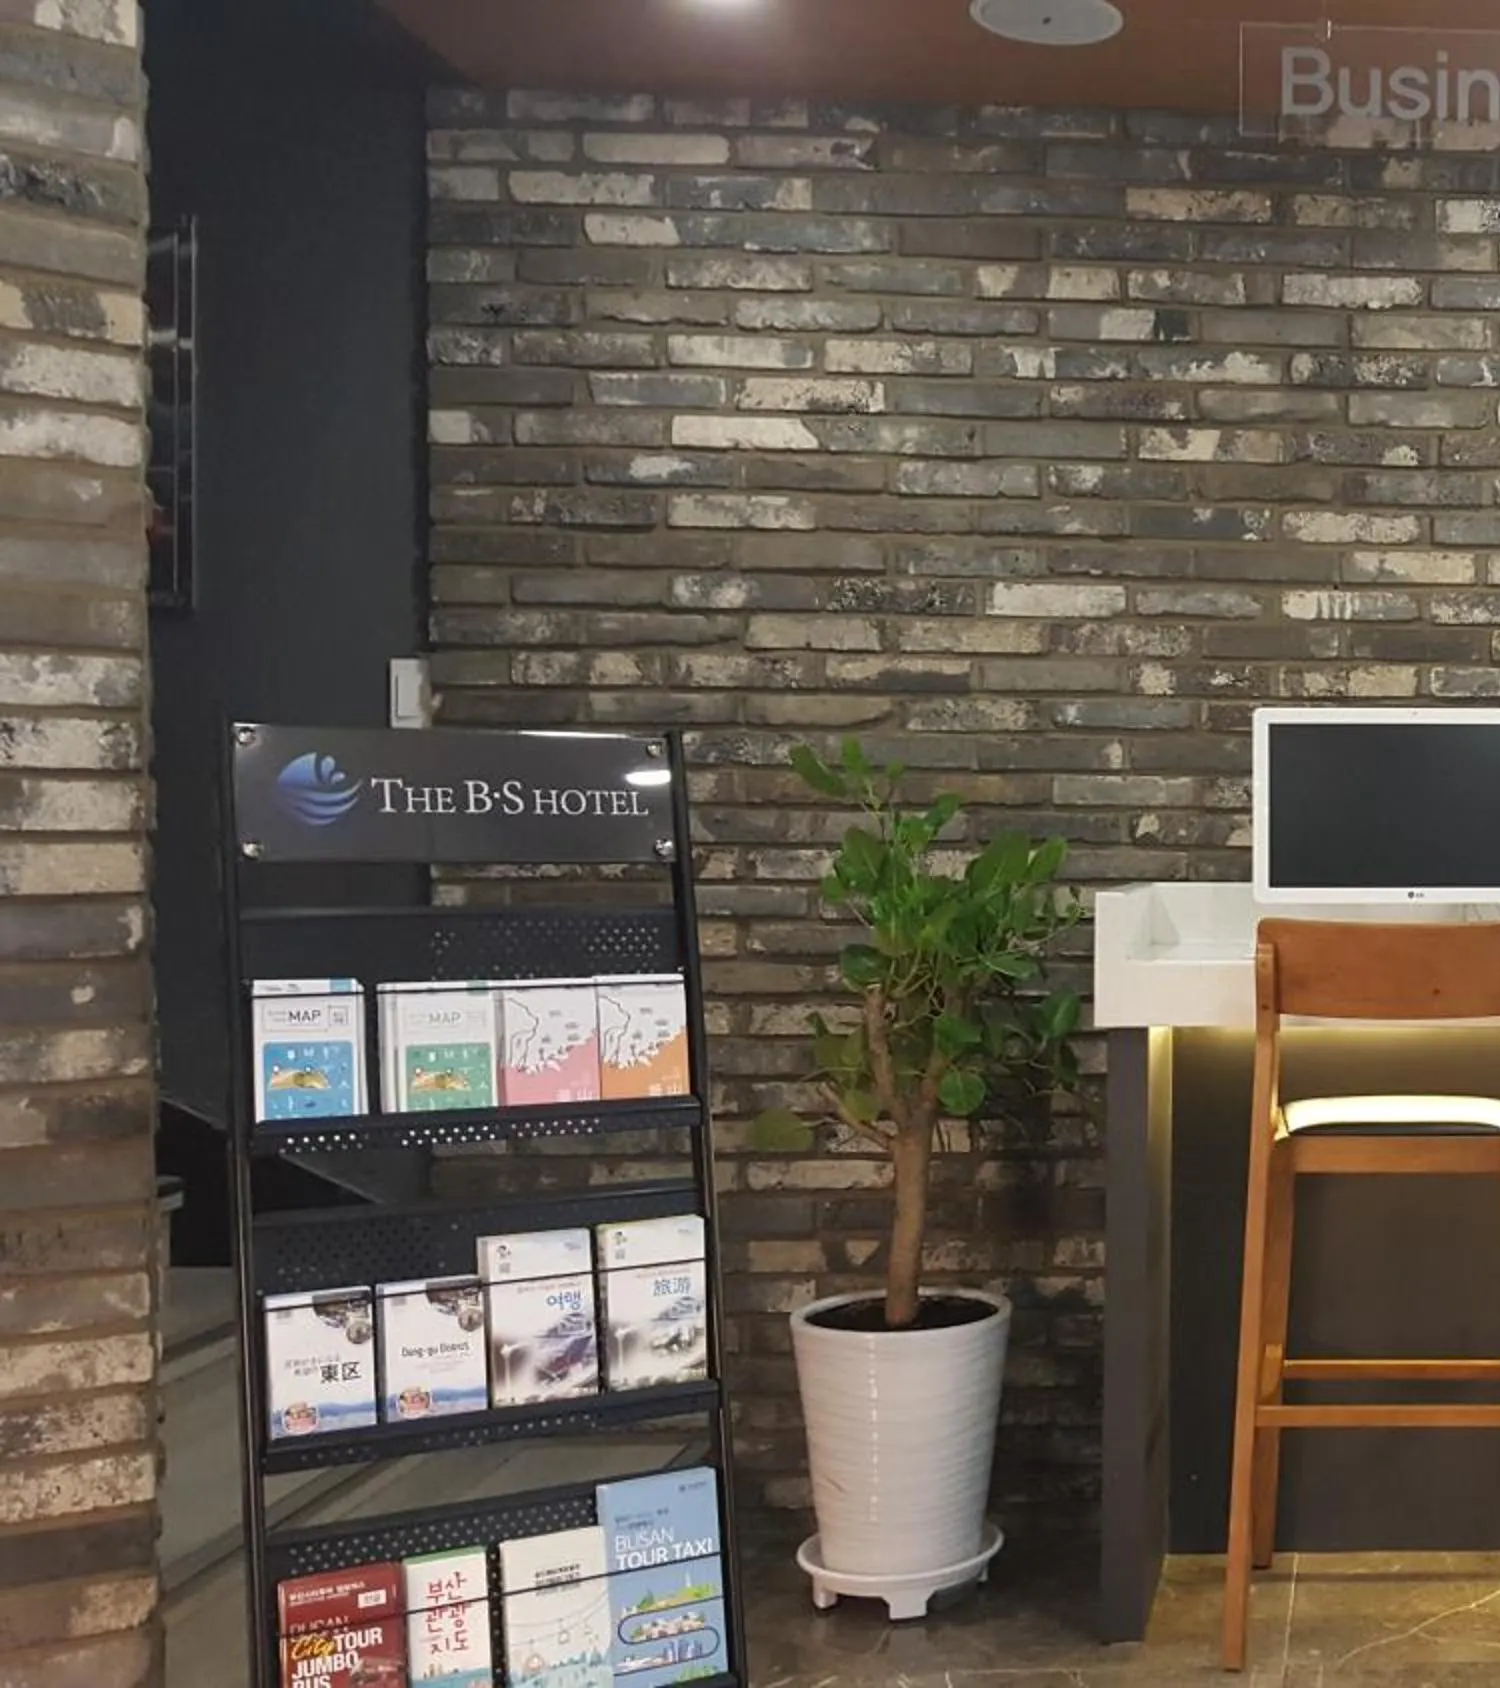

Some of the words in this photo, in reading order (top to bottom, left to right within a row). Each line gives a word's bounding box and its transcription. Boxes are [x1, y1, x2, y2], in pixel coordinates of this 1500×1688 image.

[371, 778, 457, 814] THE
[534, 789, 649, 817] HOTEL
[288, 1009, 321, 1022] MAP
[615, 1526, 675, 1553] BUSAN
[616, 1546, 669, 1571] TOUR
[672, 1537, 713, 1561] TAXI
[426, 1571, 467, 1604] 부산
[333, 1627, 383, 1652] TOUR
[431, 1629, 470, 1655] 지도
[291, 1651, 360, 1680] JUMBO
